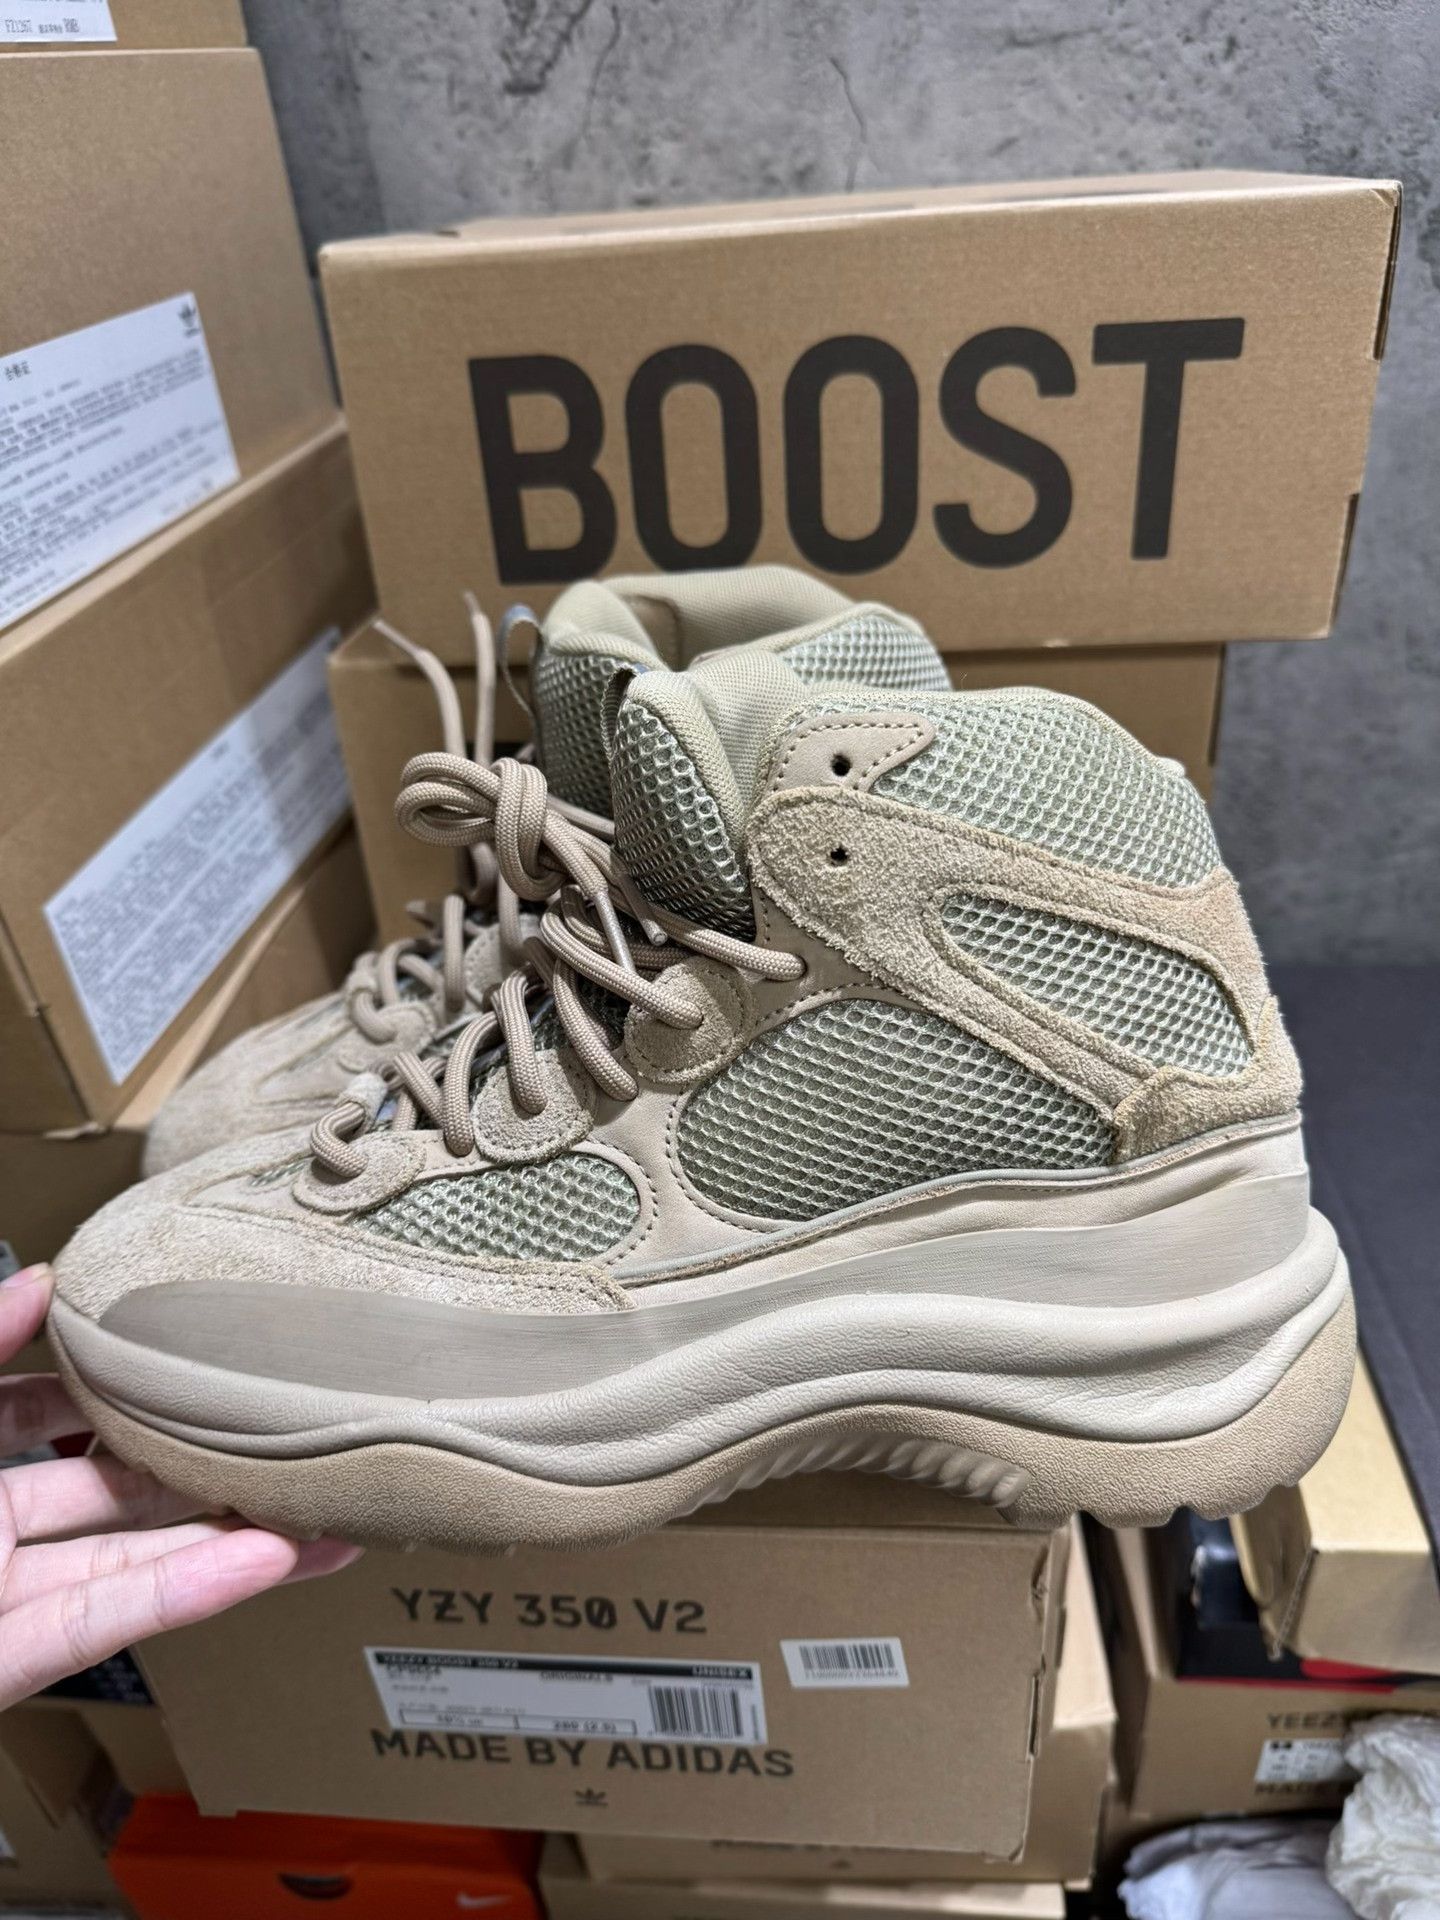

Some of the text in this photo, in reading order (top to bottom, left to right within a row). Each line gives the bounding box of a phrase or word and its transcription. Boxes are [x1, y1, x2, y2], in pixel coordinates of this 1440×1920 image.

[468, 317, 1245, 586] BOOST
[391, 1587, 708, 1635] YZY 350 V2
[370, 1730, 795, 1779] MADE BY ADIDAS
